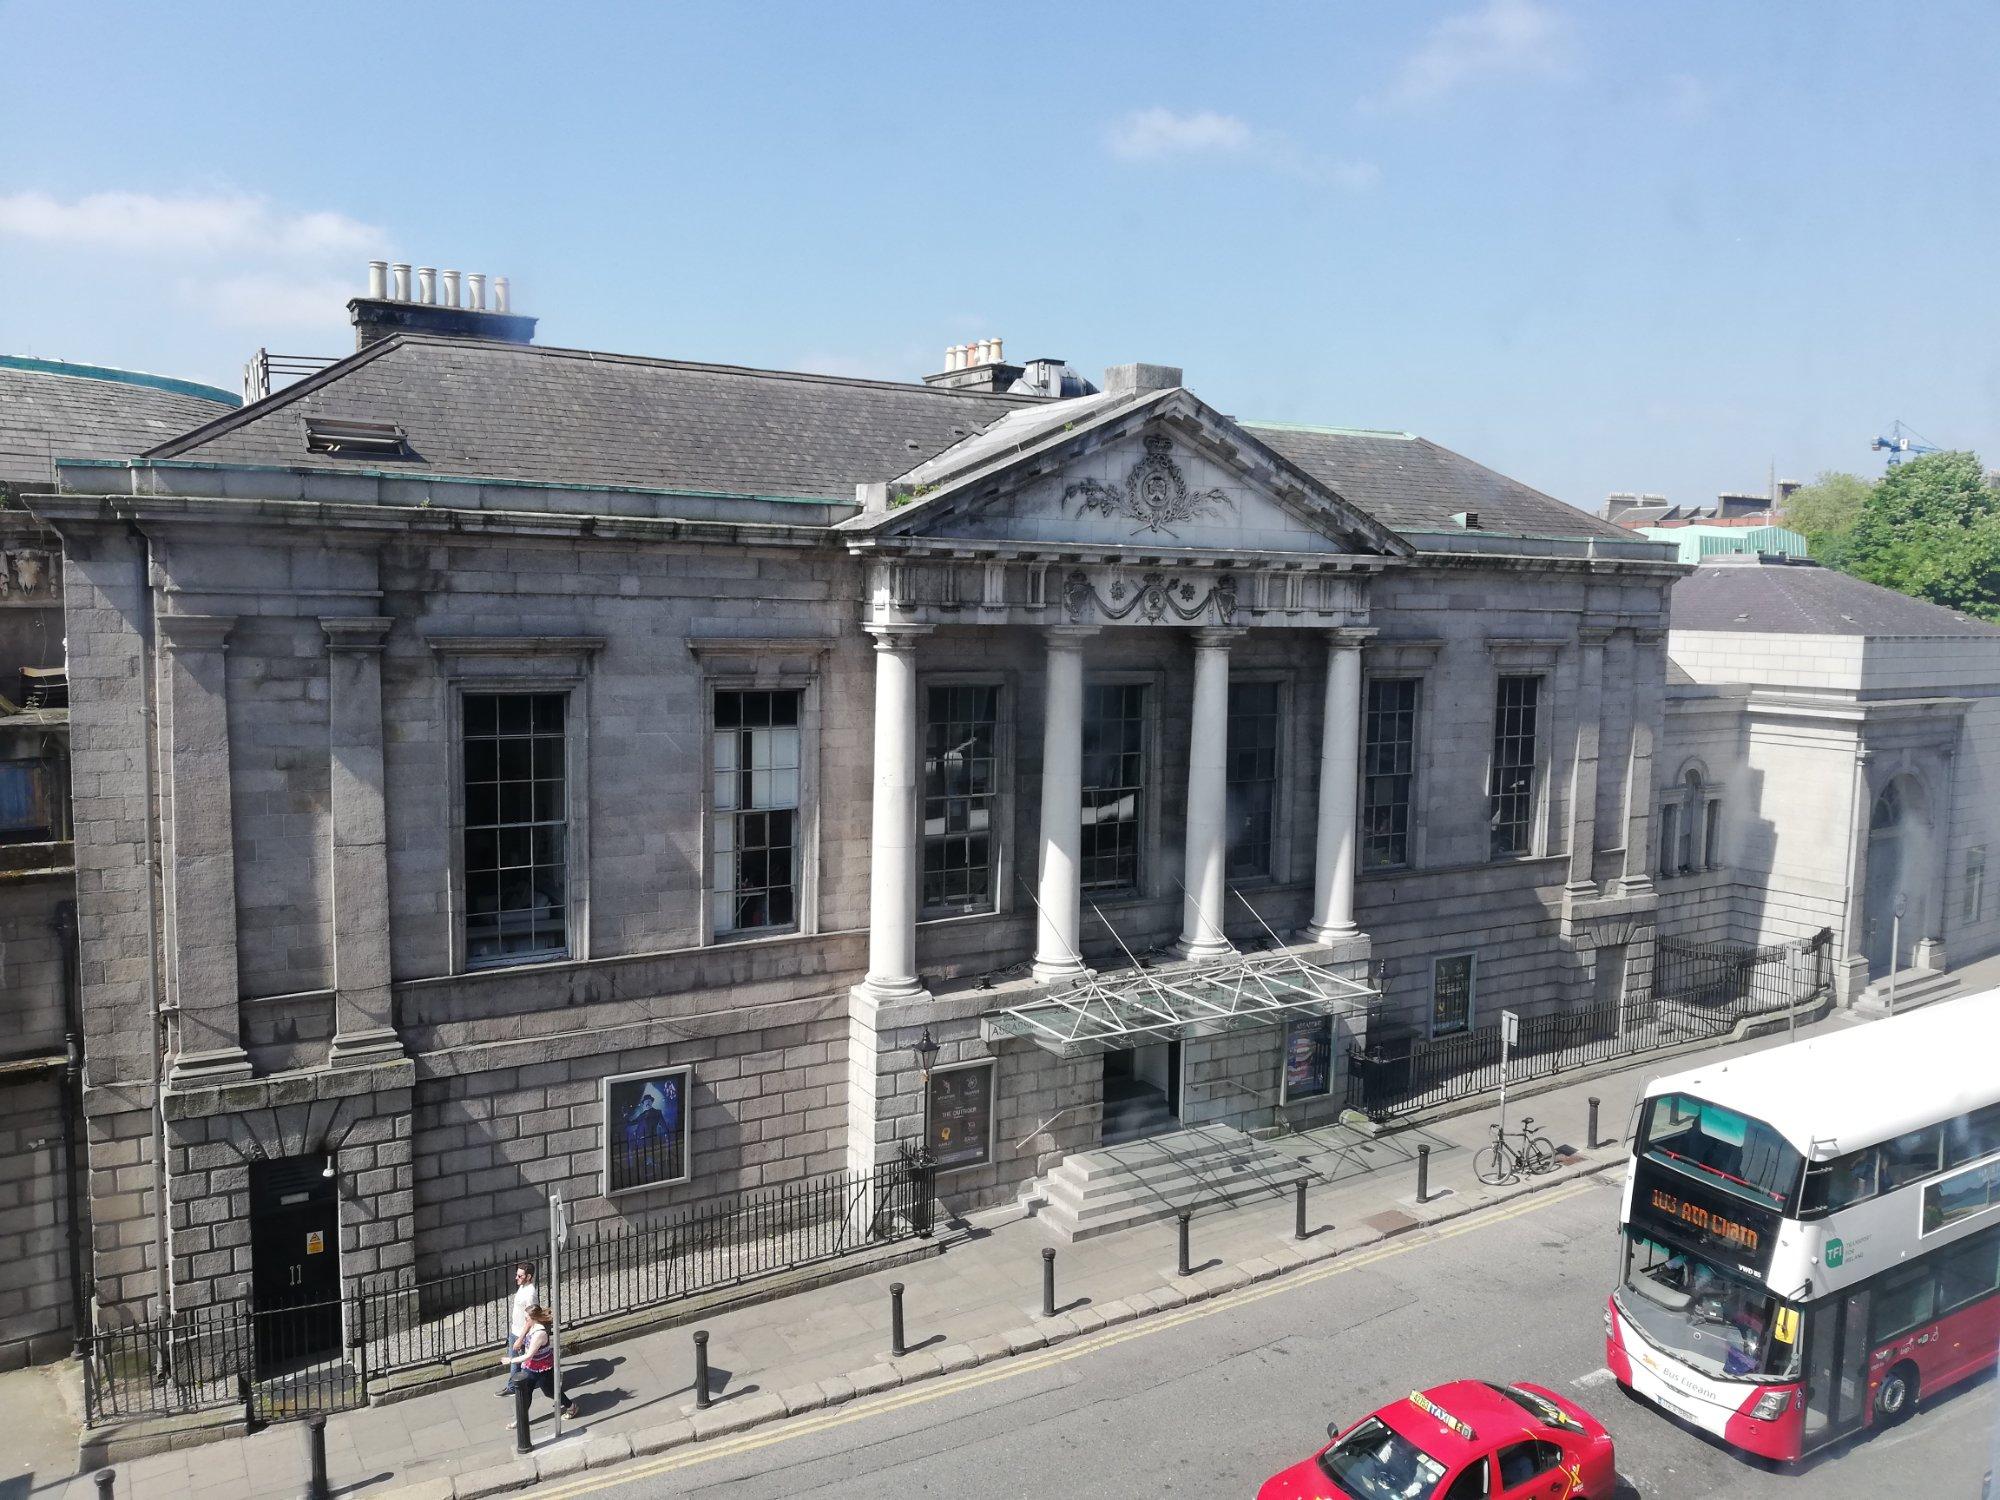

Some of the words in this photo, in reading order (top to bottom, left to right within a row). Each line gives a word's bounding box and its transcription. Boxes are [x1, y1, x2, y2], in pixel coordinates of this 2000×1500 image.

[1827, 1246, 1842, 1260] TFI
[1663, 1367, 1679, 1381] Bus
[1431, 1404, 1451, 1424] TAXI
